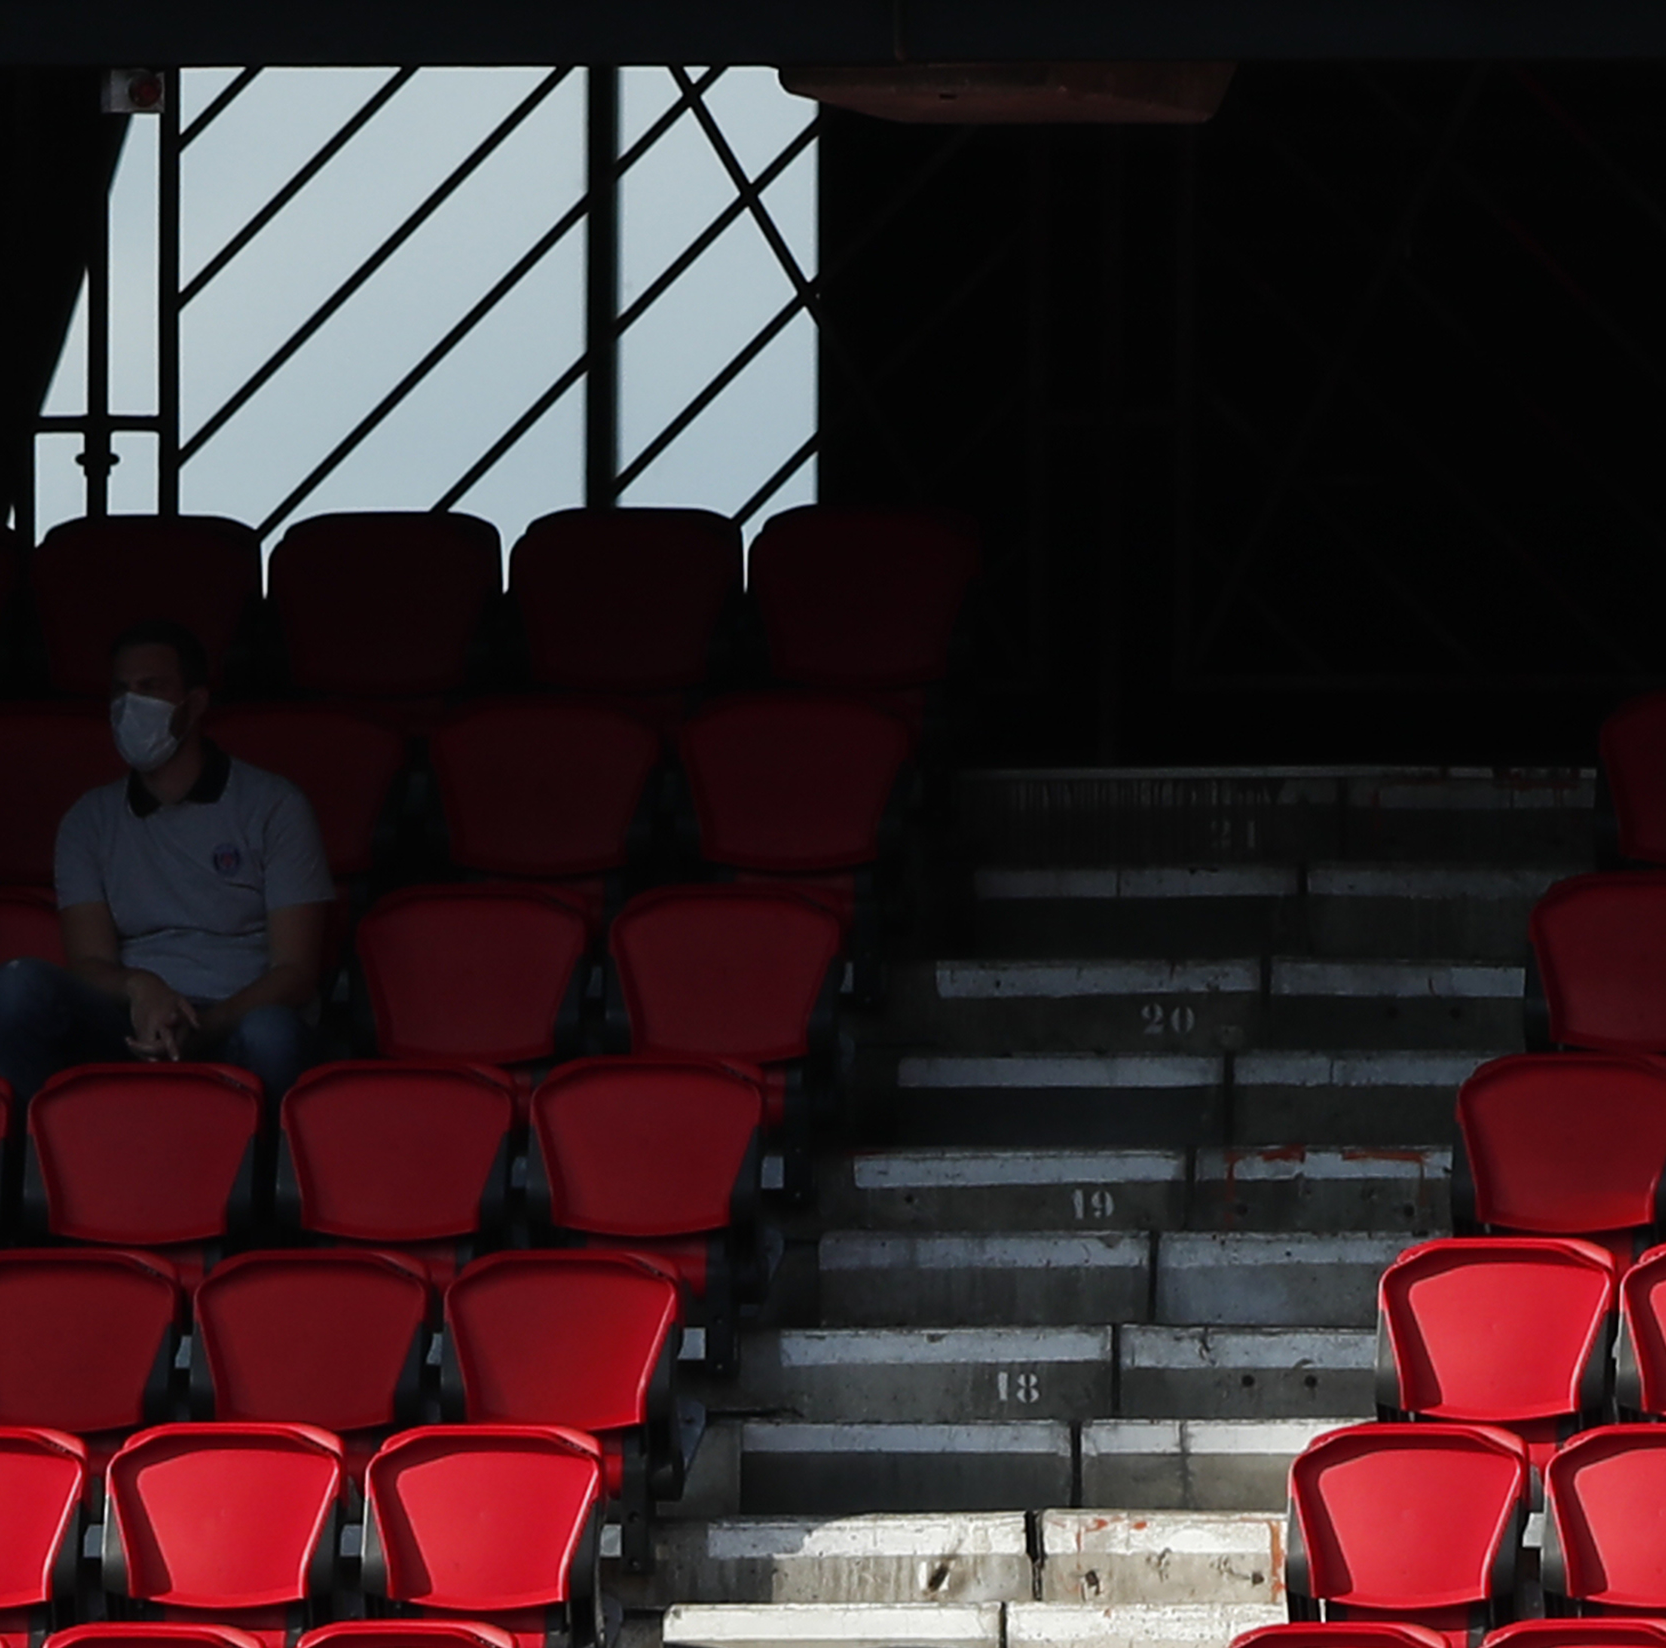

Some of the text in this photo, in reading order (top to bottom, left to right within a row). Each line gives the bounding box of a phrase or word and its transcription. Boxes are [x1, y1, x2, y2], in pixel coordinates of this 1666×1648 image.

[1141, 1003, 1196, 1035] 20
[1071, 1189, 1115, 1222] 19
[996, 1371, 1039, 1404] 18
